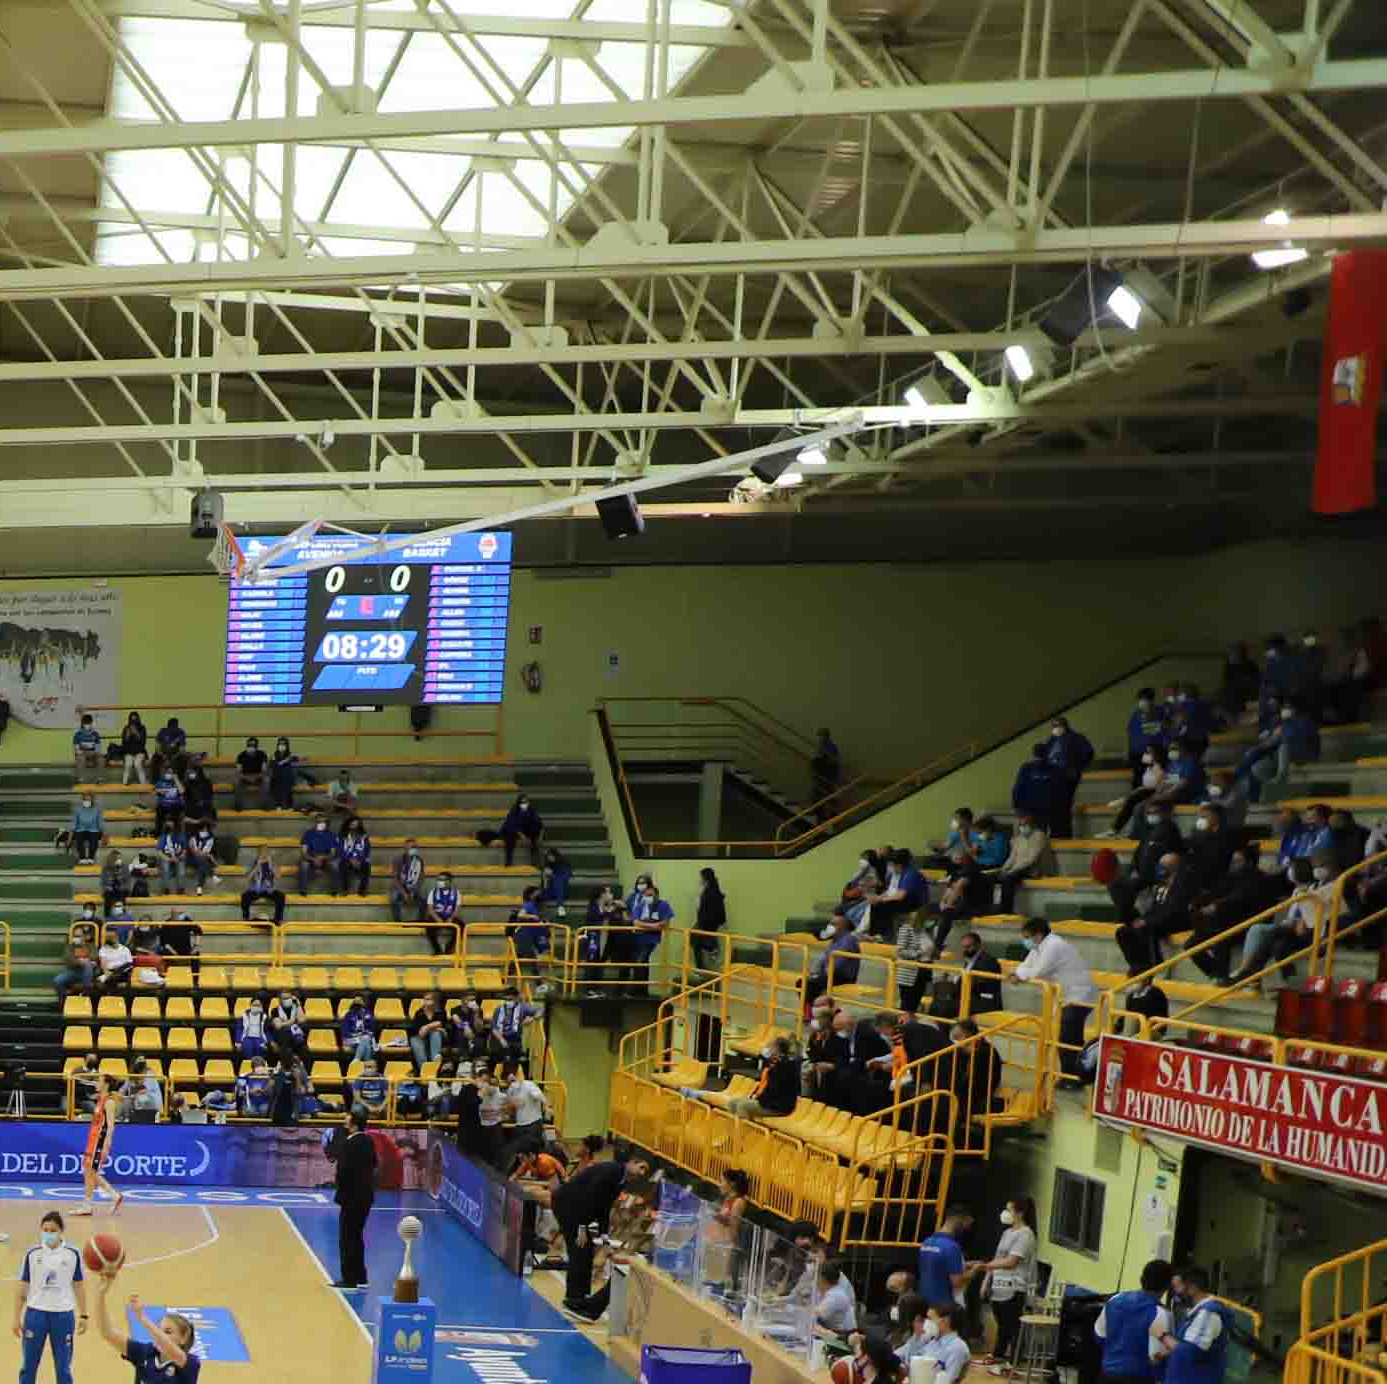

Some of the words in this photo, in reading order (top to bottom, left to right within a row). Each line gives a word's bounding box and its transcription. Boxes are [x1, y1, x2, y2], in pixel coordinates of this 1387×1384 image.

[325, 565, 346, 593] 0
[390, 564, 411, 592] 0
[323, 633, 406, 659] 08:29
[1156, 1050, 1383, 1135] SALAMANCA
[1123, 1087, 1225, 1139] PATRIMONIO
[1228, 1110, 1255, 1146] DE
[1257, 1119, 1281, 1152] LA
[1286, 1125, 1387, 1180] HUMANID
[1, 1151, 54, 1175] DEL
